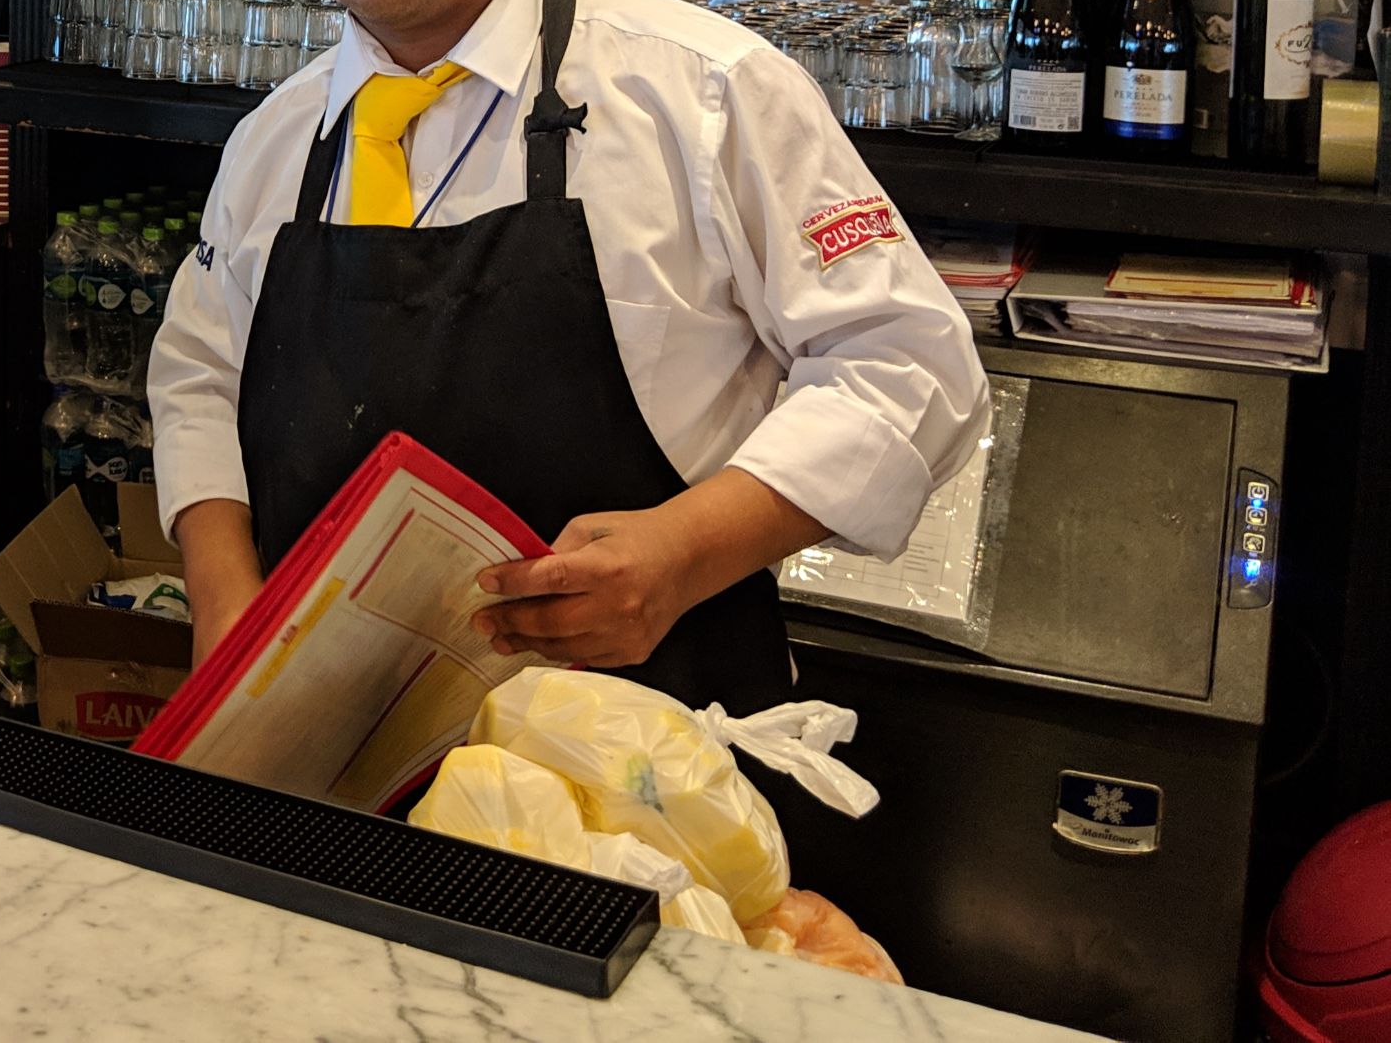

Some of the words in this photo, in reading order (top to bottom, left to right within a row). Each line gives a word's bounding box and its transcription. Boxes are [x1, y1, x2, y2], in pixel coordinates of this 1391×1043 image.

[1114, 90, 1173, 102] PERELADA
[802, 200, 853, 229] CERVEZA
[1082, 827, 1140, 846] Manitowoc
